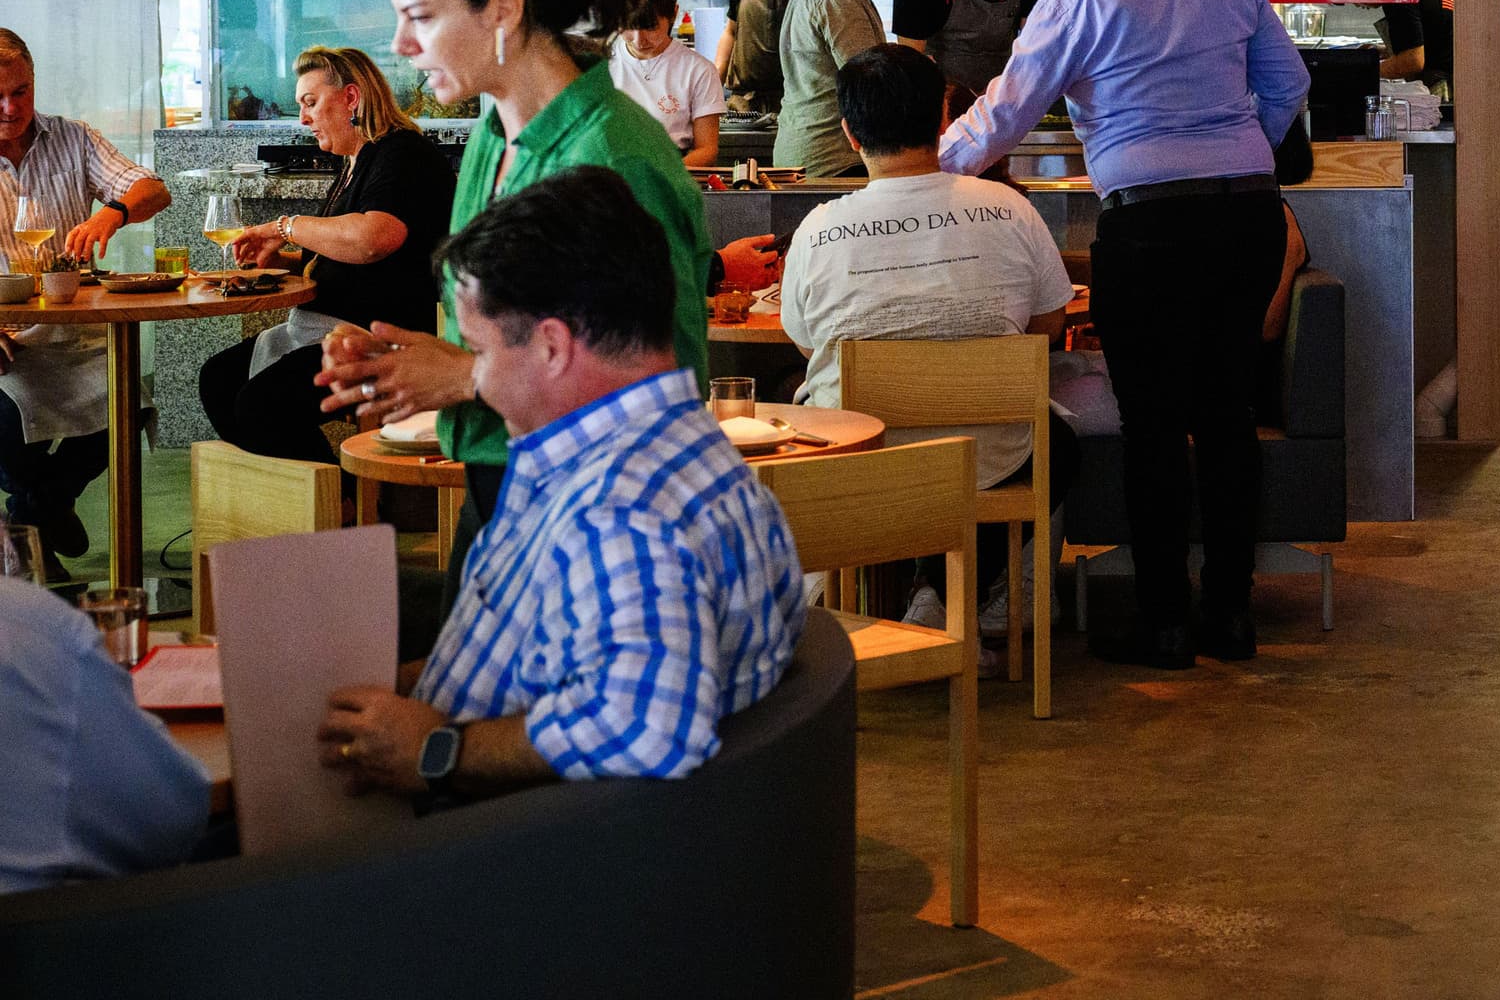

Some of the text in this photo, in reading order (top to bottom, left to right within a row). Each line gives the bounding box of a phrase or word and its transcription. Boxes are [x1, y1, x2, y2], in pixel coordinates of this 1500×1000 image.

[810, 206, 1012, 248] LEONARDO DA VINCI
